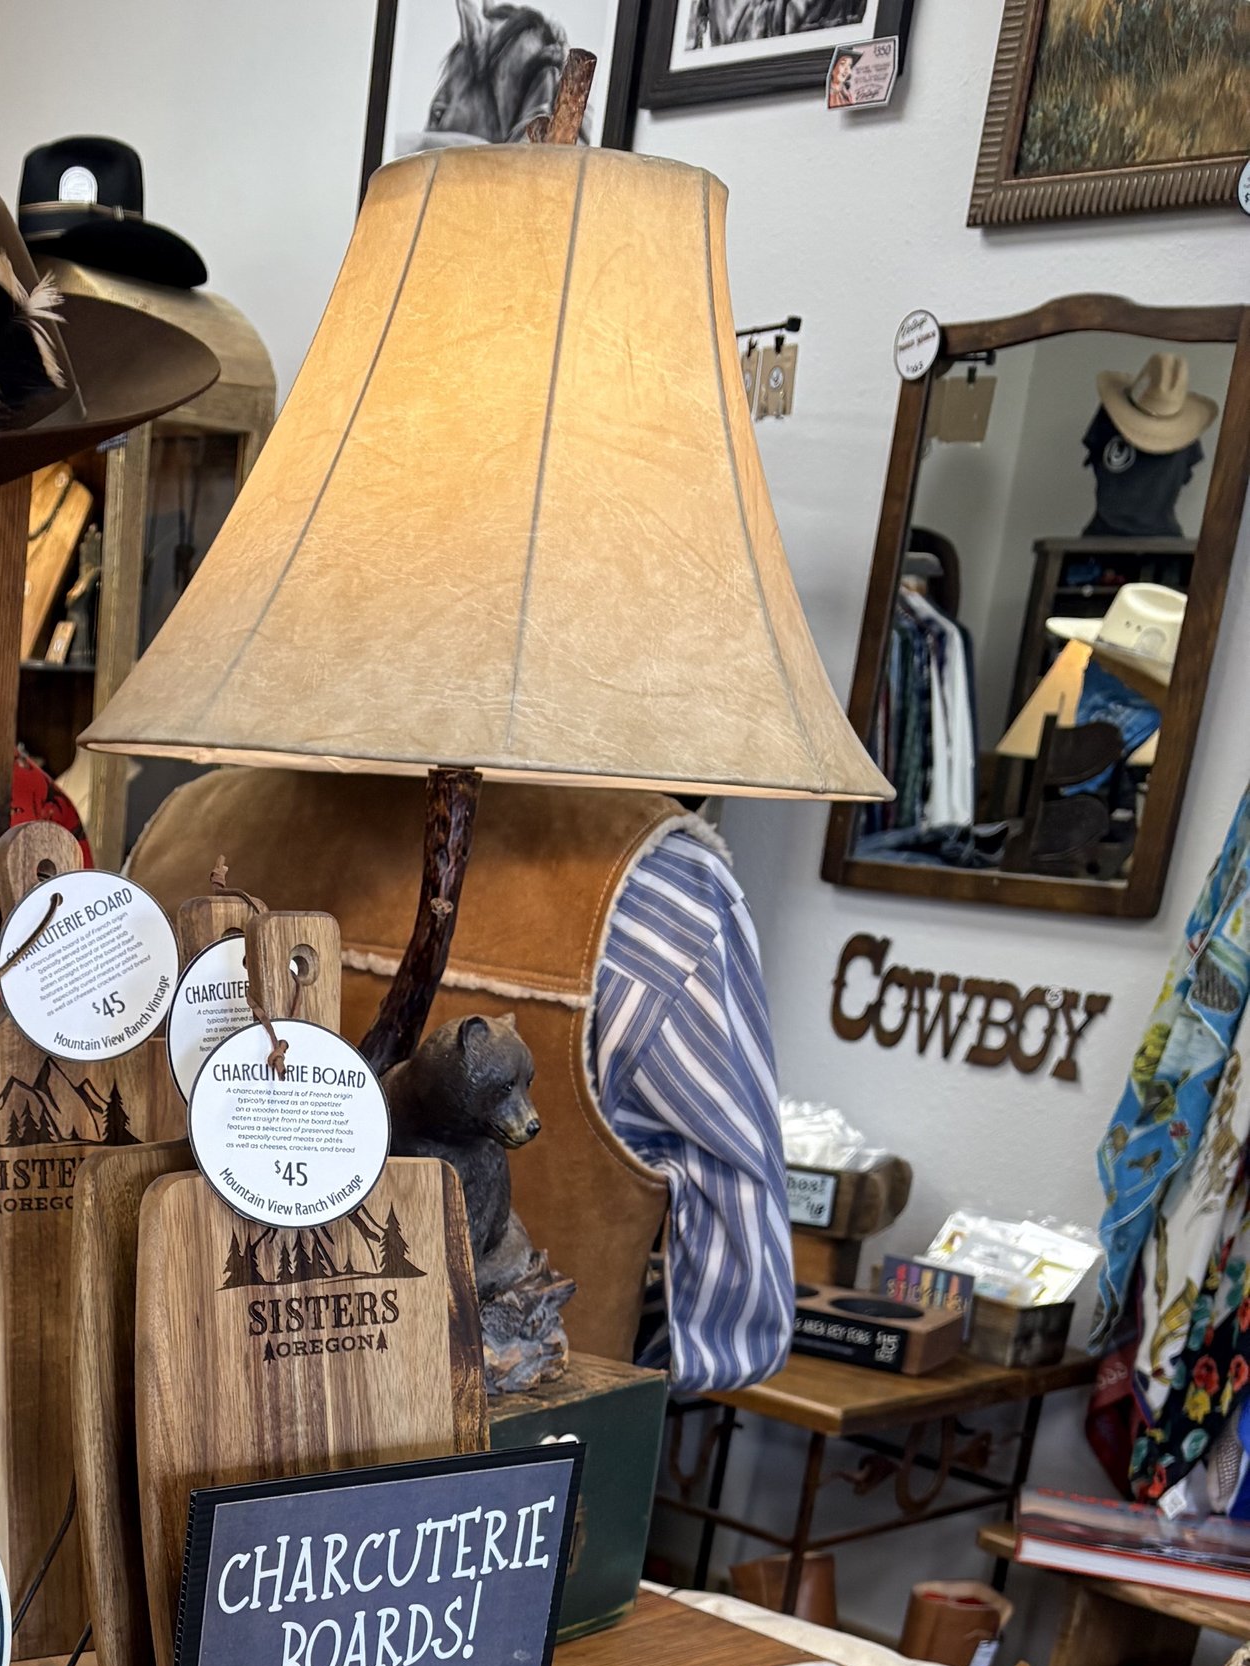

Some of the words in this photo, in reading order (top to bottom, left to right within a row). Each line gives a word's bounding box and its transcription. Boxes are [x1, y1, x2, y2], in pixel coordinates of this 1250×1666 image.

[85, 887, 133, 921] BOARD
[53, 1031, 101, 1051] Mountain
[103, 1032, 126, 1049] View
[124, 1012, 151, 1038] Ranch
[149, 975, 170, 1019] Vintage
[92, 990, 126, 1018] $45
[312, 1065, 366, 1089] BOARD
[232, 1087, 271, 1095] charcuterie
[333, 1092, 353, 1100] origin
[237, 1096, 266, 1105] typically
[309, 1100, 341, 1109] appetizer
[253, 1115, 279, 1123] straight
[301, 1126, 333, 1135] preserved
[237, 1132, 270, 1141] especially
[323, 1136, 342, 1144] pâtés
[259, 1143, 287, 1151] cheeses,
[289, 1144, 318, 1153] crackers,
[274, 1160, 308, 1187] $45
[219, 1167, 265, 1210] Mountain
[267, 1200, 293, 1216] View
[295, 1199, 329, 1216] Ranch
[328, 1173, 364, 1207] Vintage
[248, 1289, 400, 1336] SISTERS
[276, 1334, 375, 1357] OREGON
[217, 1496, 555, 1614] CHARCUTERIE
